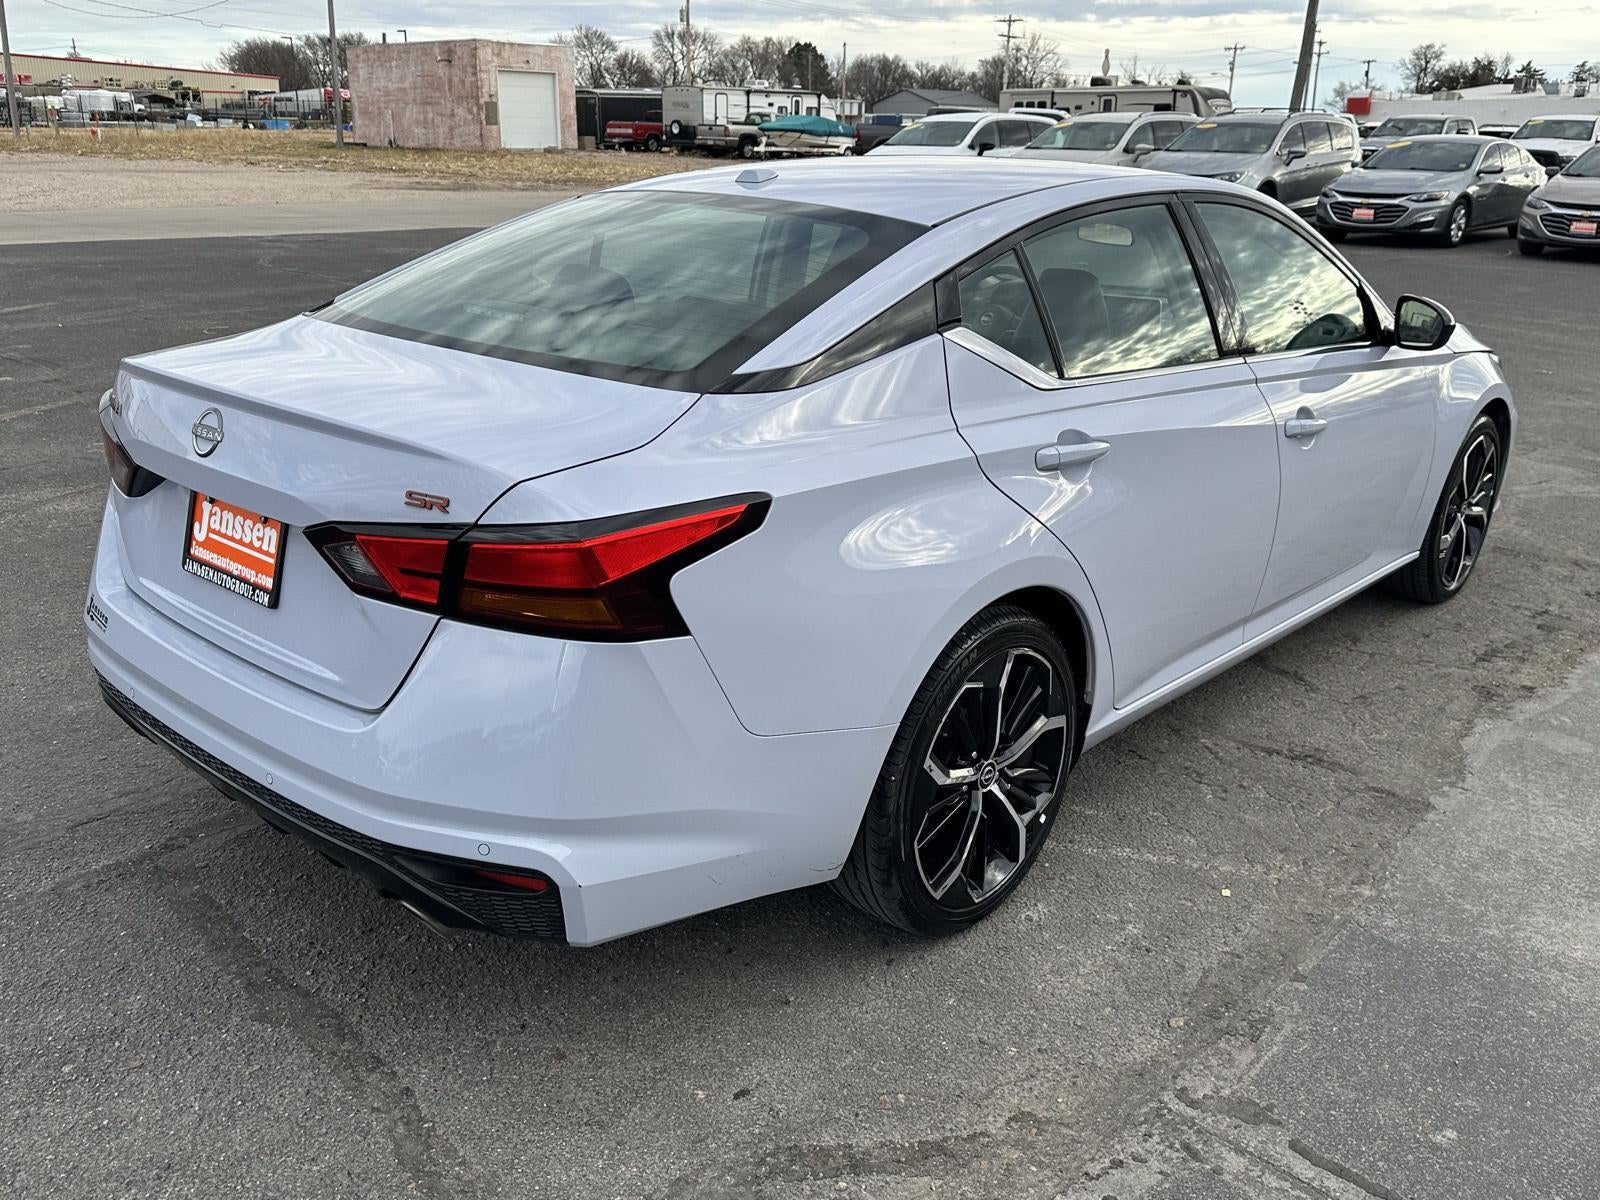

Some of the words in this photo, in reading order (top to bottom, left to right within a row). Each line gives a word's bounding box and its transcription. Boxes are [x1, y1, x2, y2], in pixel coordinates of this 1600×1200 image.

[404, 490, 450, 514] SR
[193, 501, 277, 554] Janssen
[184, 558, 269, 607] JANSSENAUTOGROUP.COM
[190, 541, 273, 588] Janssenautogroup.com
